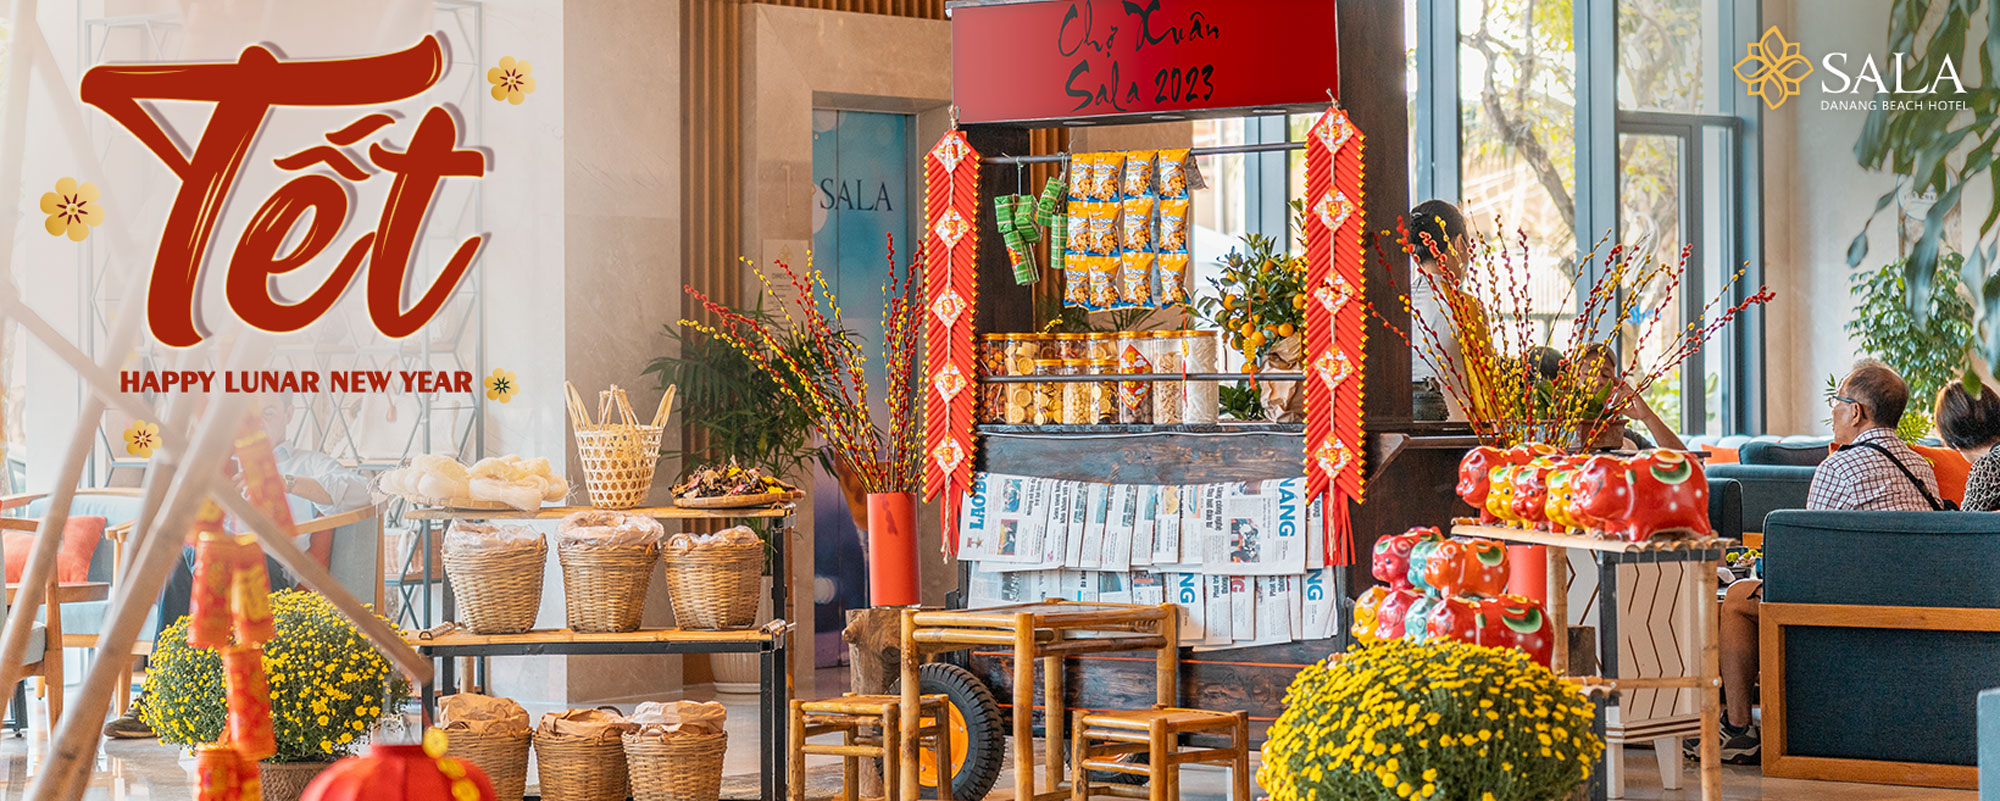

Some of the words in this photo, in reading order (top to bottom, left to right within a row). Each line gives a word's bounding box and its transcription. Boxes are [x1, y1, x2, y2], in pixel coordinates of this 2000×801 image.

[1058, 0, 1118, 58] Chợ
[1121, 0, 1220, 52] Xuân
[1064, 59, 1142, 113] Sala
[1154, 64, 1214, 104] 2023
[819, 178, 893, 212] SALA
